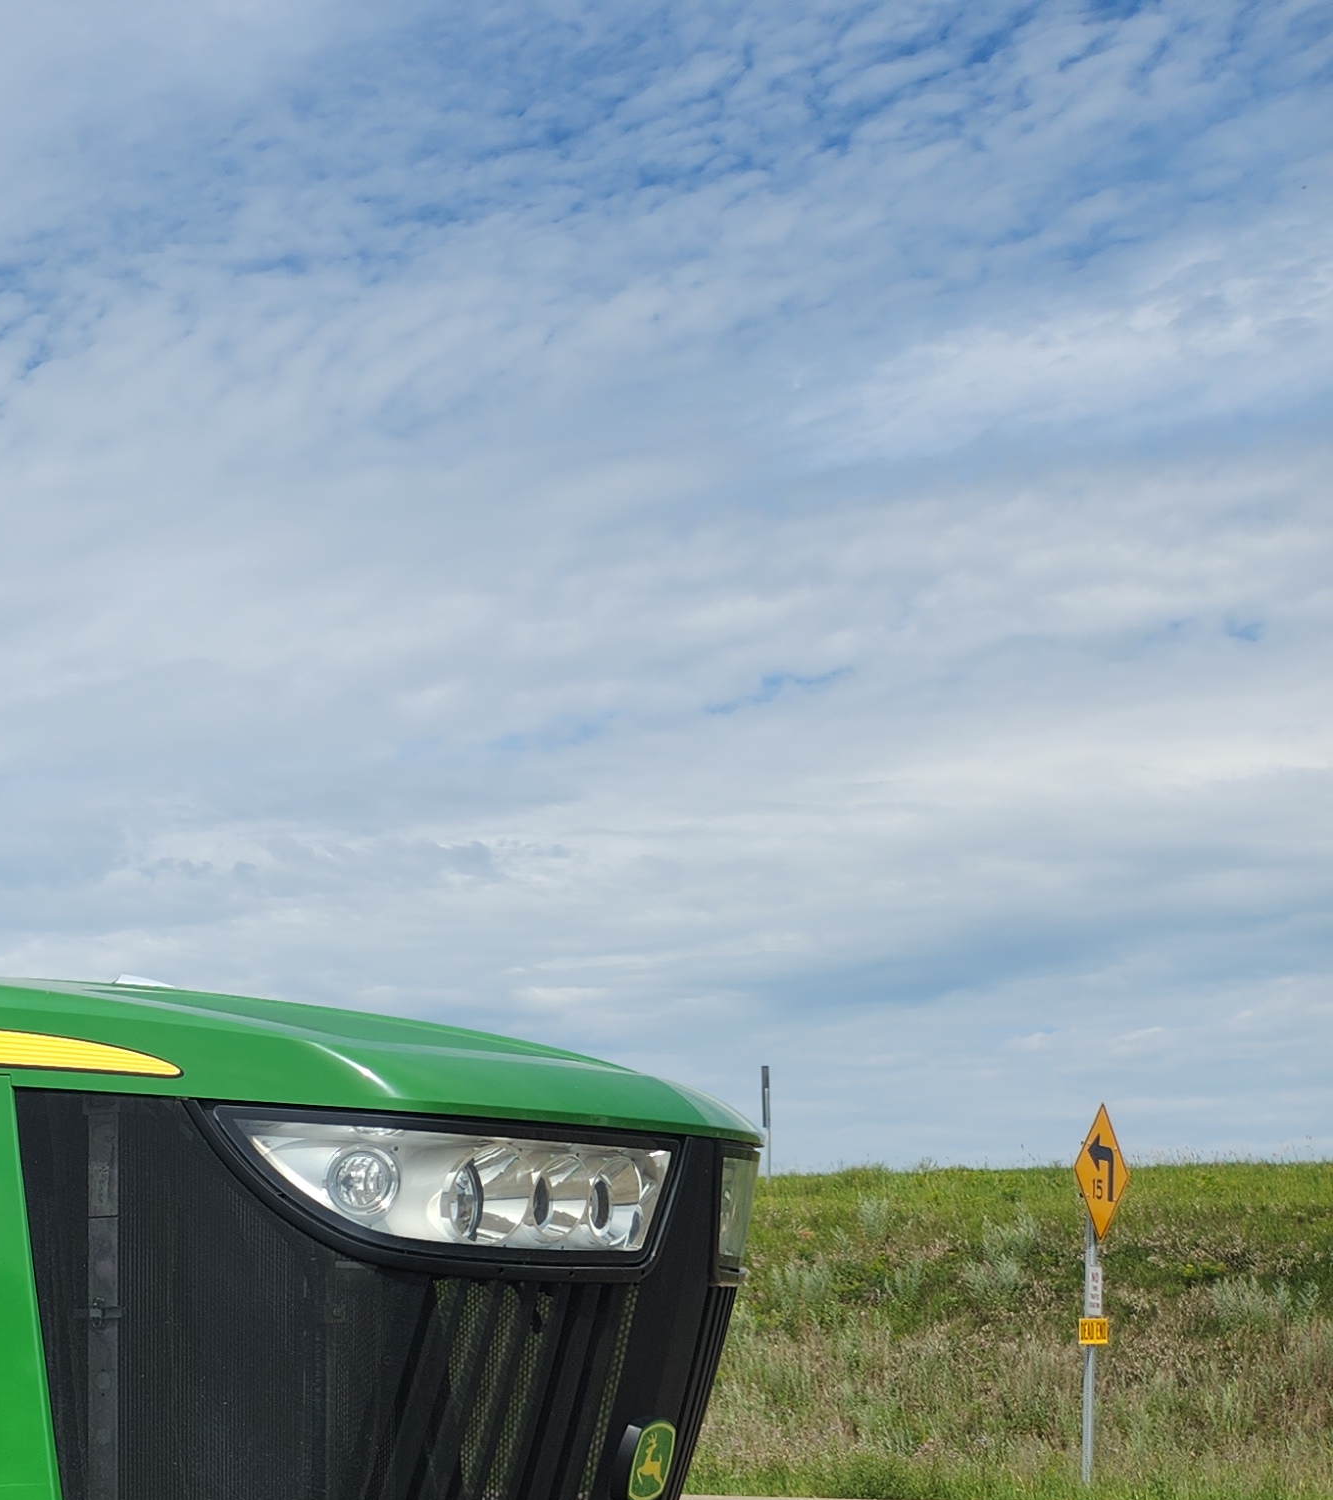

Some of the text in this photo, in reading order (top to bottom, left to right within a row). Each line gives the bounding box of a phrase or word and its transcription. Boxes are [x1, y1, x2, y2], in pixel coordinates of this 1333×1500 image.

[1092, 1178, 1103, 1200] 15
[1080, 1322, 1106, 1340] DEAD END
